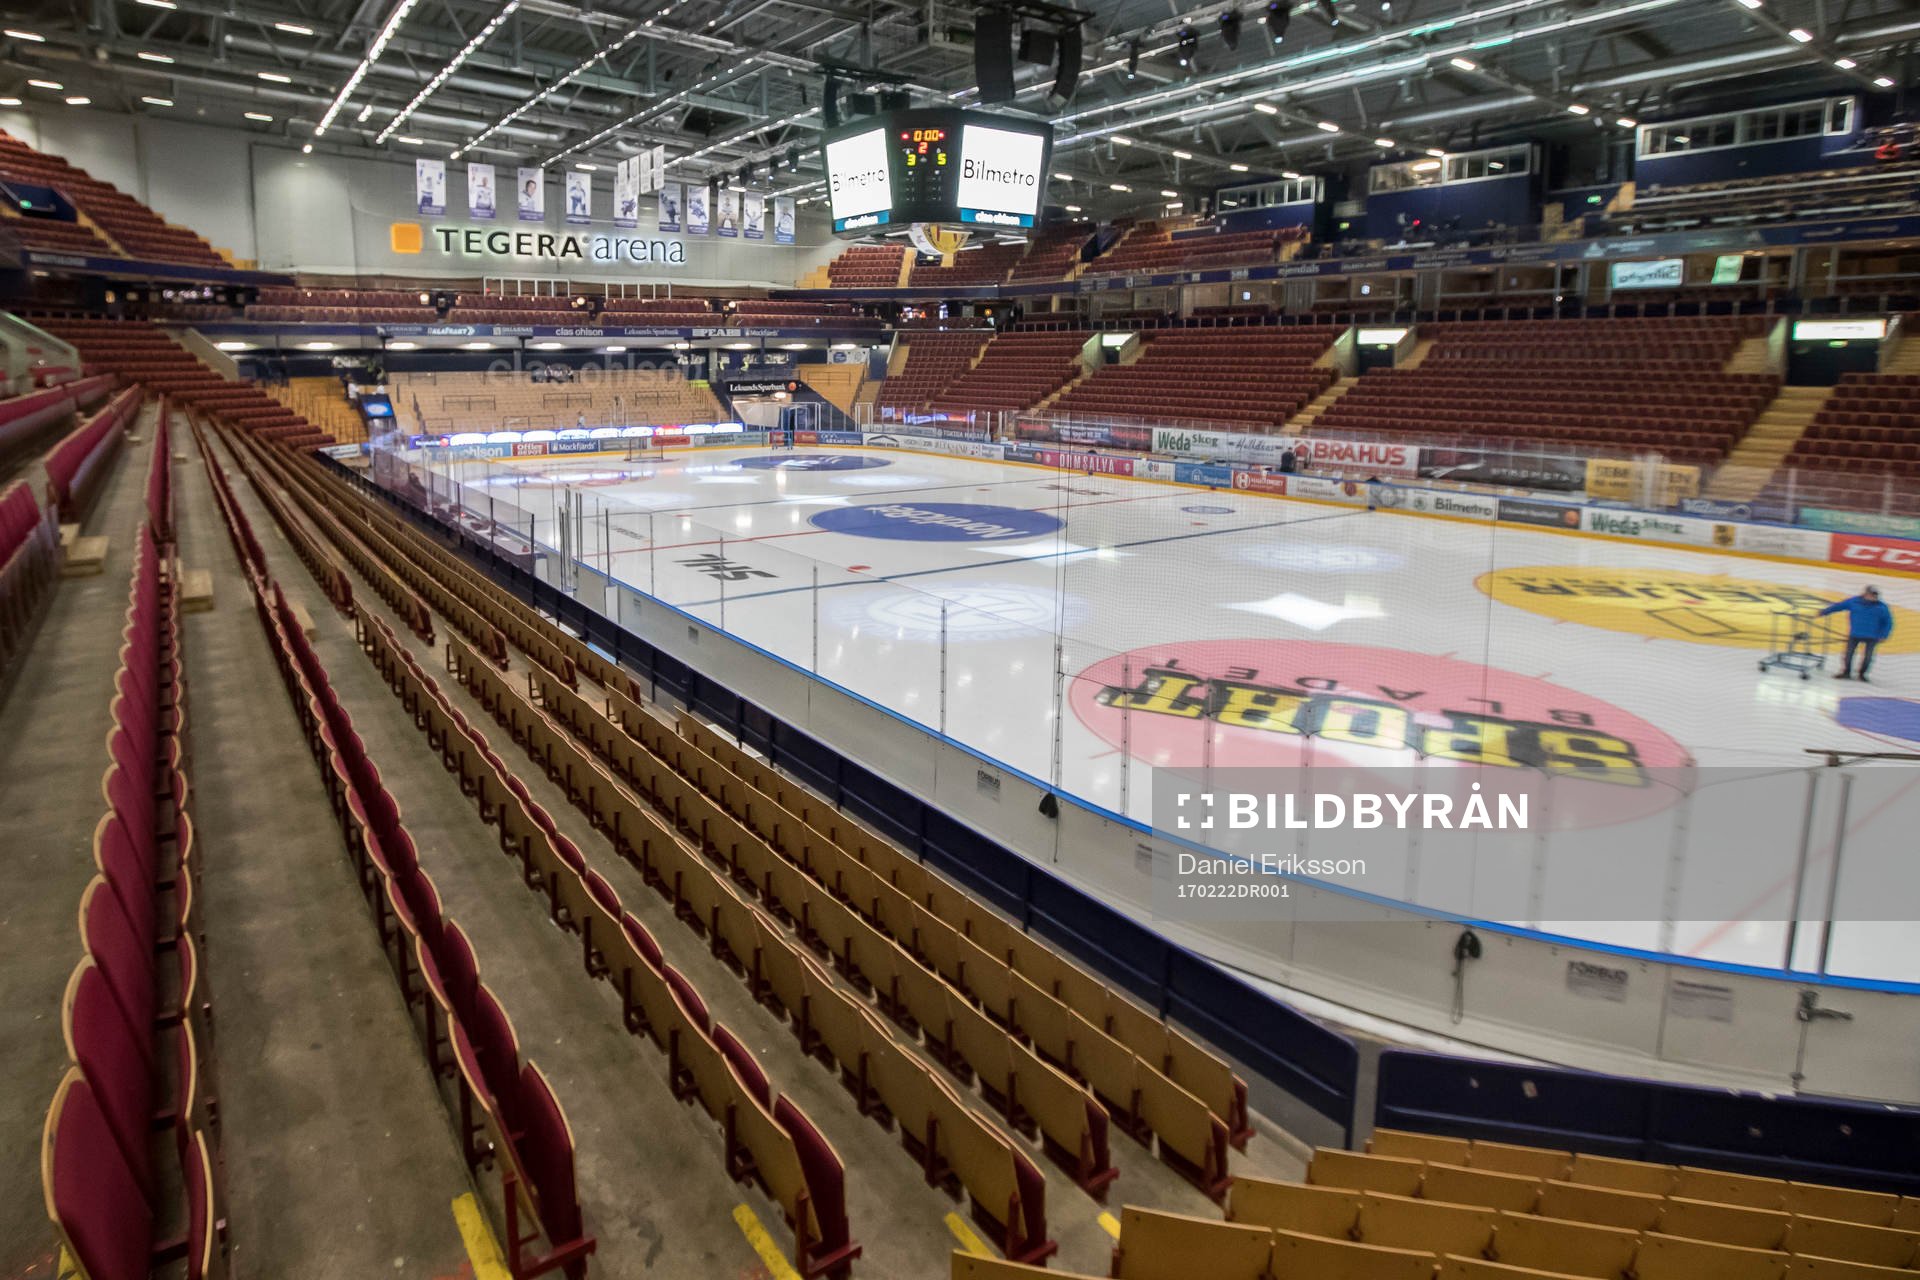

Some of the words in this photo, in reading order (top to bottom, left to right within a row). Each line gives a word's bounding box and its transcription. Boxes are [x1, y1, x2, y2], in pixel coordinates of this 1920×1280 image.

[918, 142, 928, 154] 2
[907, 154, 916, 166] 3
[937, 153, 947, 165] 5
[963, 159, 1035, 187] Bilmetro
[436, 228, 584, 258] TEGERA
[594, 234, 686, 263] arena
[555, 328, 574, 336] clas
[575, 328, 604, 336] ohlson
[1158, 431, 1191, 451] Weda
[1434, 497, 1492, 516] Bilmetro
[1591, 512, 1640, 535] Weda
[1842, 543, 1920, 564] CC
[1095, 667, 1652, 788] SPORT
